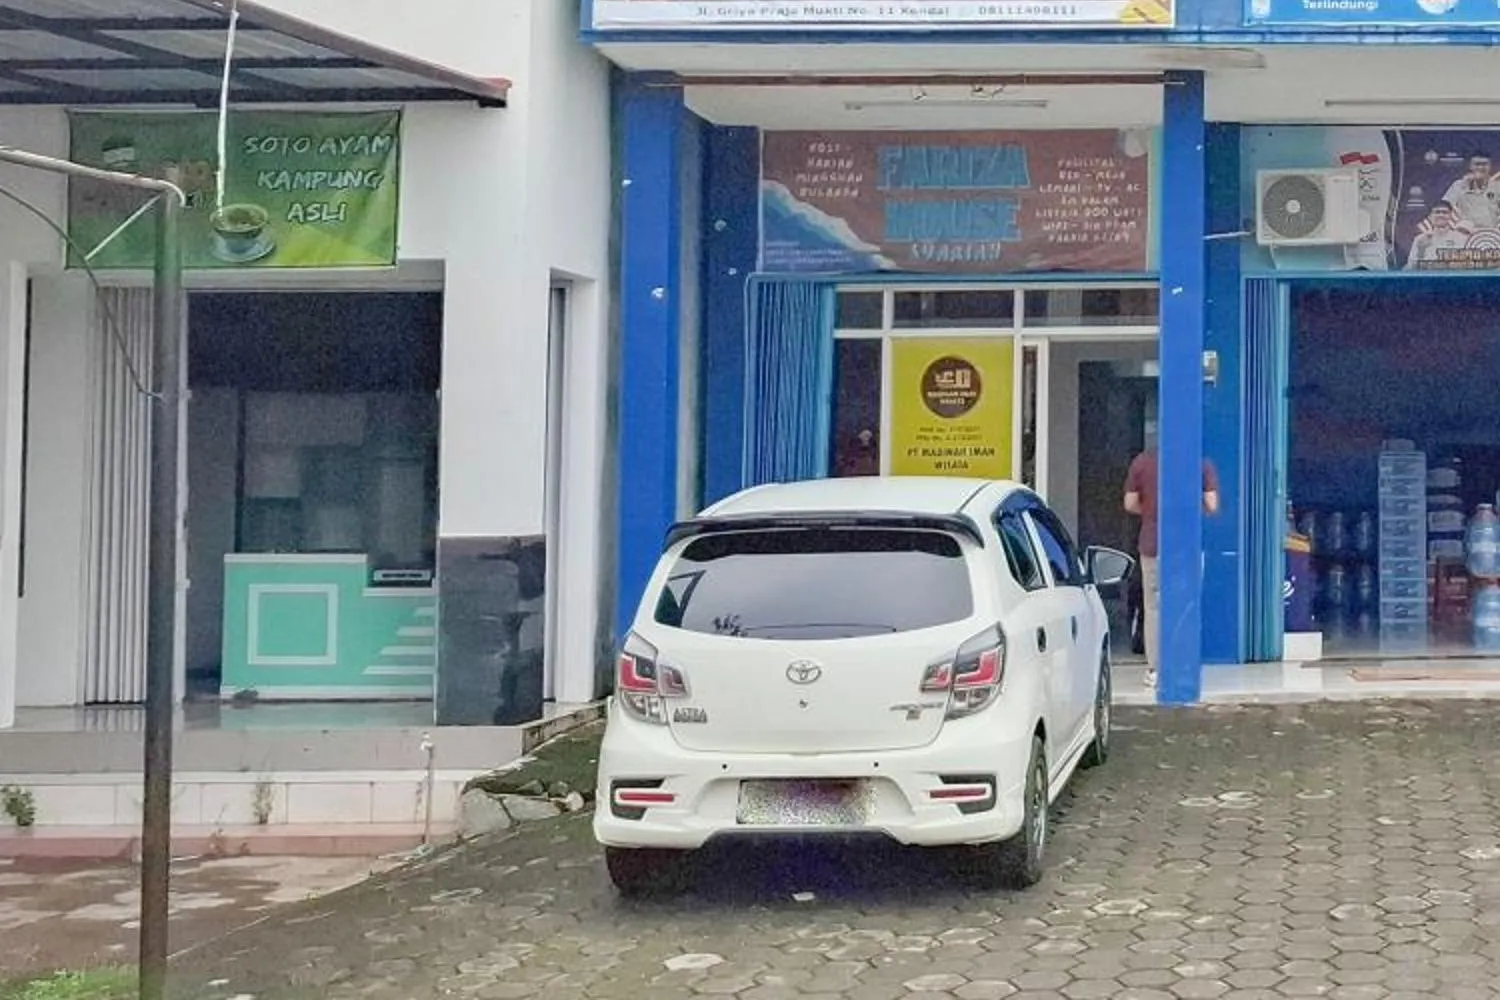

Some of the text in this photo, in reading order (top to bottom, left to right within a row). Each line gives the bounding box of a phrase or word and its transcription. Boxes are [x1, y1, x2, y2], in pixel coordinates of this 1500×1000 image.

[244, 135, 391, 156] SOTO AYAM
[257, 169, 383, 191] KAMPUNG
[287, 202, 347, 223] ASLI
